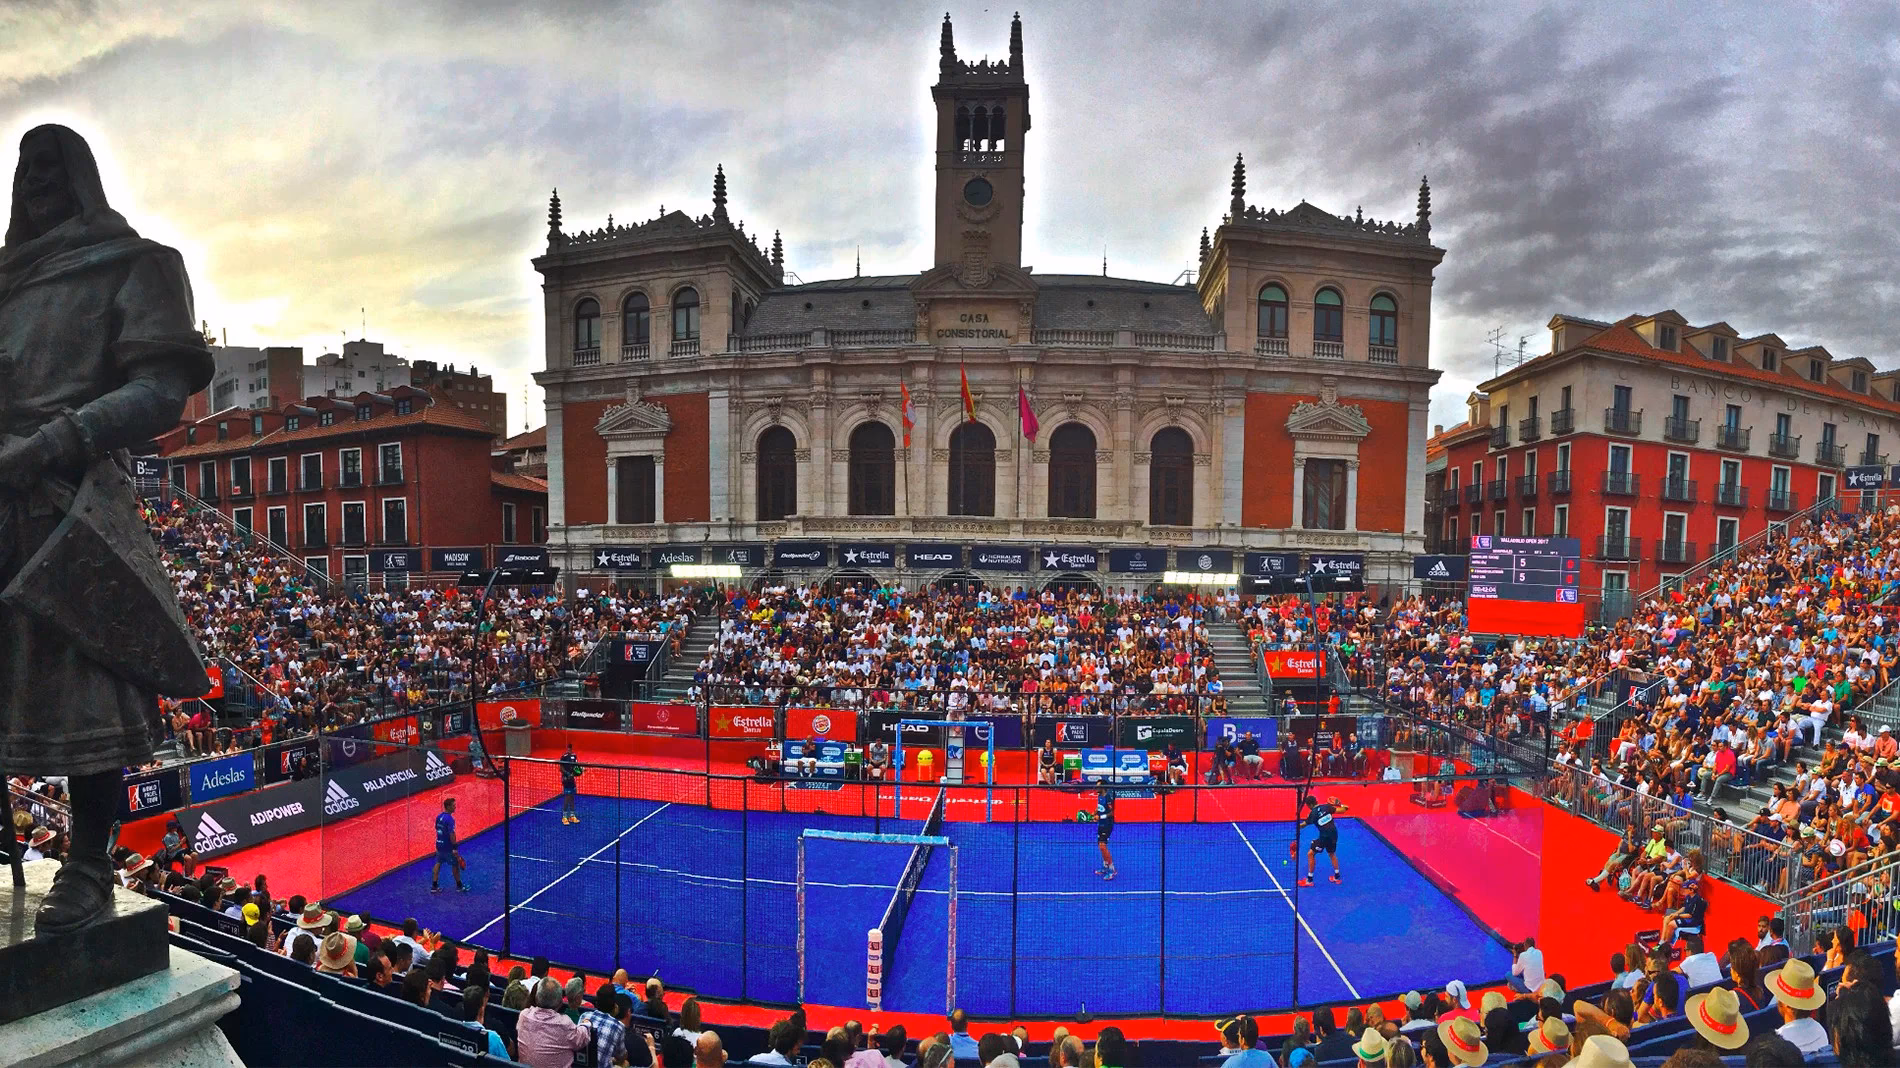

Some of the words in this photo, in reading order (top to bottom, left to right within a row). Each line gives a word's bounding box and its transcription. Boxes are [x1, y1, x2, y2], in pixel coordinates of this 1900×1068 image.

[960, 313, 989, 323] CASA
[937, 329, 1012, 339] CONSISTORIAL
[1670, 375, 1752, 402] BANCO
[1787, 397, 1811, 415] DE
[444, 553, 469, 561] MADISON
[611, 552, 640, 562] Estrella
[659, 552, 694, 563] Adeslas
[860, 550, 889, 559] Estrella
[1061, 553, 1095, 563] Estrella
[1328, 560, 1360, 570] Estrella
[1520, 559, 1526, 567] 5
[1519, 573, 1525, 581] 5
[733, 716, 772, 727] Estrella
[882, 723, 929, 733] HEAD
[426, 764, 453, 782] adidas
[201, 767, 246, 791] Adeslas
[362, 777, 386, 793] PALA
[387, 768, 418, 786] OFICIAL
[324, 797, 360, 816] adidas
[250, 802, 305, 827] ADIPOWER
[194, 831, 239, 854] adidas
